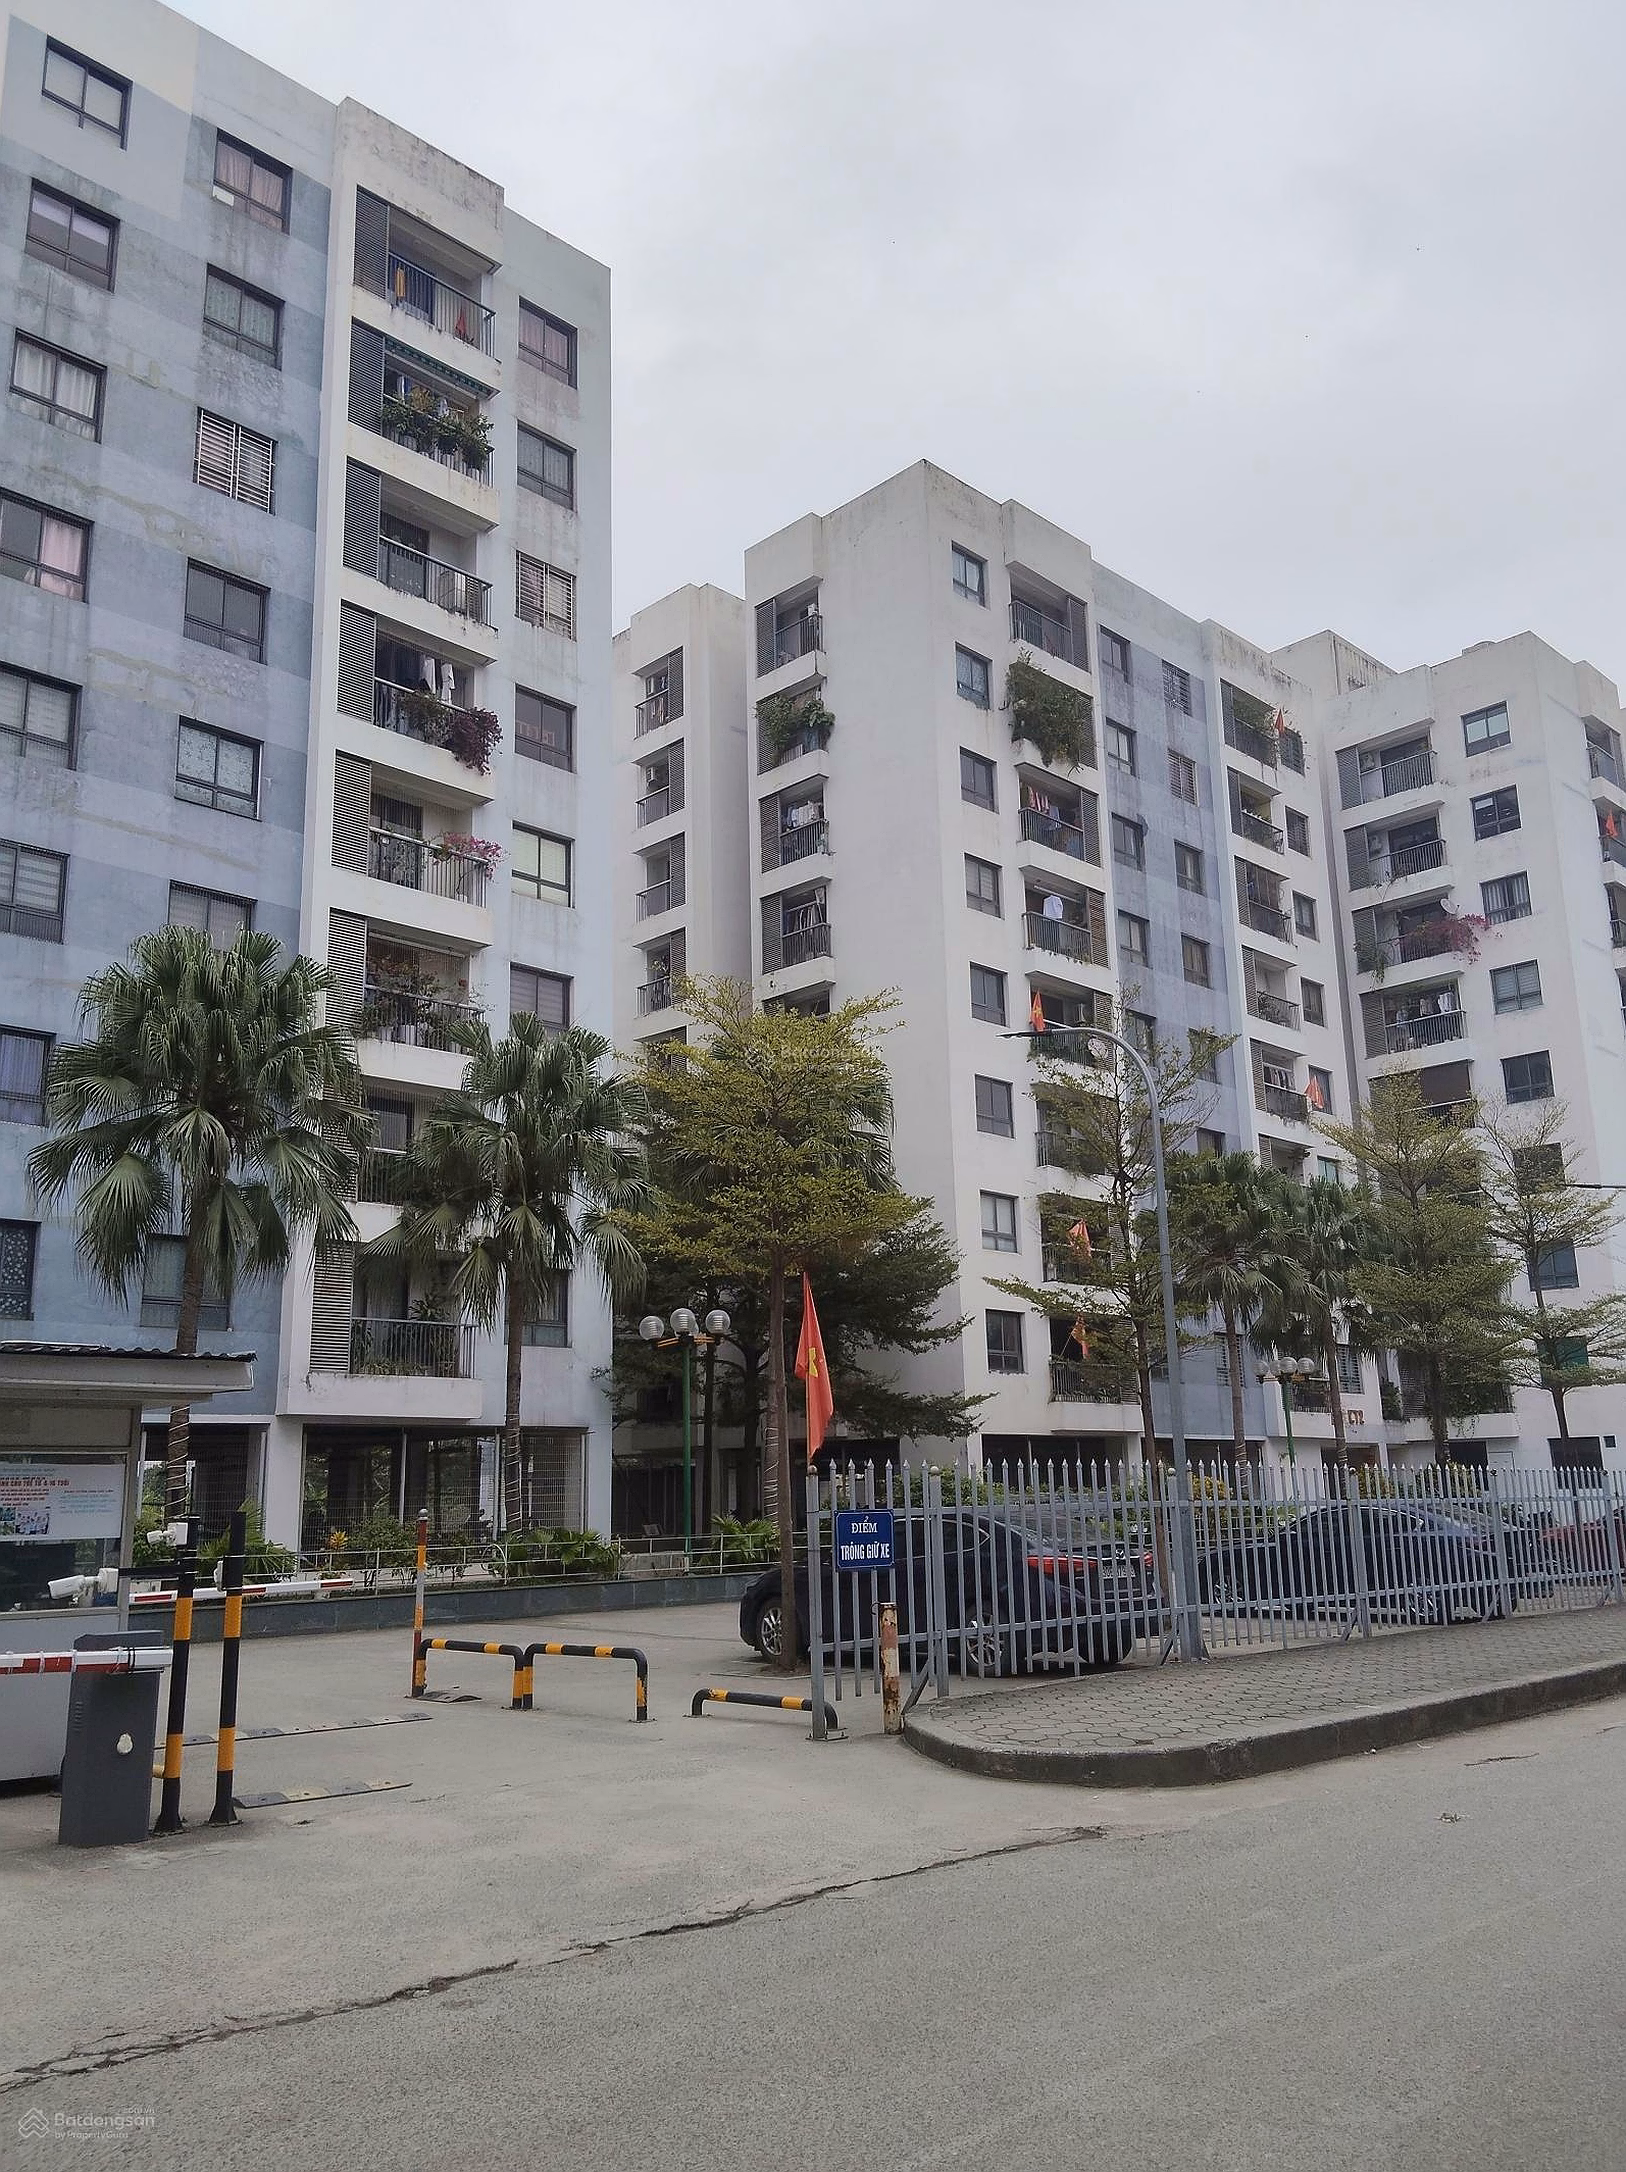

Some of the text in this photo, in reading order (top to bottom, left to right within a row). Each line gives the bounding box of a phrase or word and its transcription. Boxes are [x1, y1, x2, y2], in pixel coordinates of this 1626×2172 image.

[851, 1515, 878, 1533] ĐIỂM
[866, 1541, 880, 1559] GIỮ
[880, 1543, 890, 1559] XE
